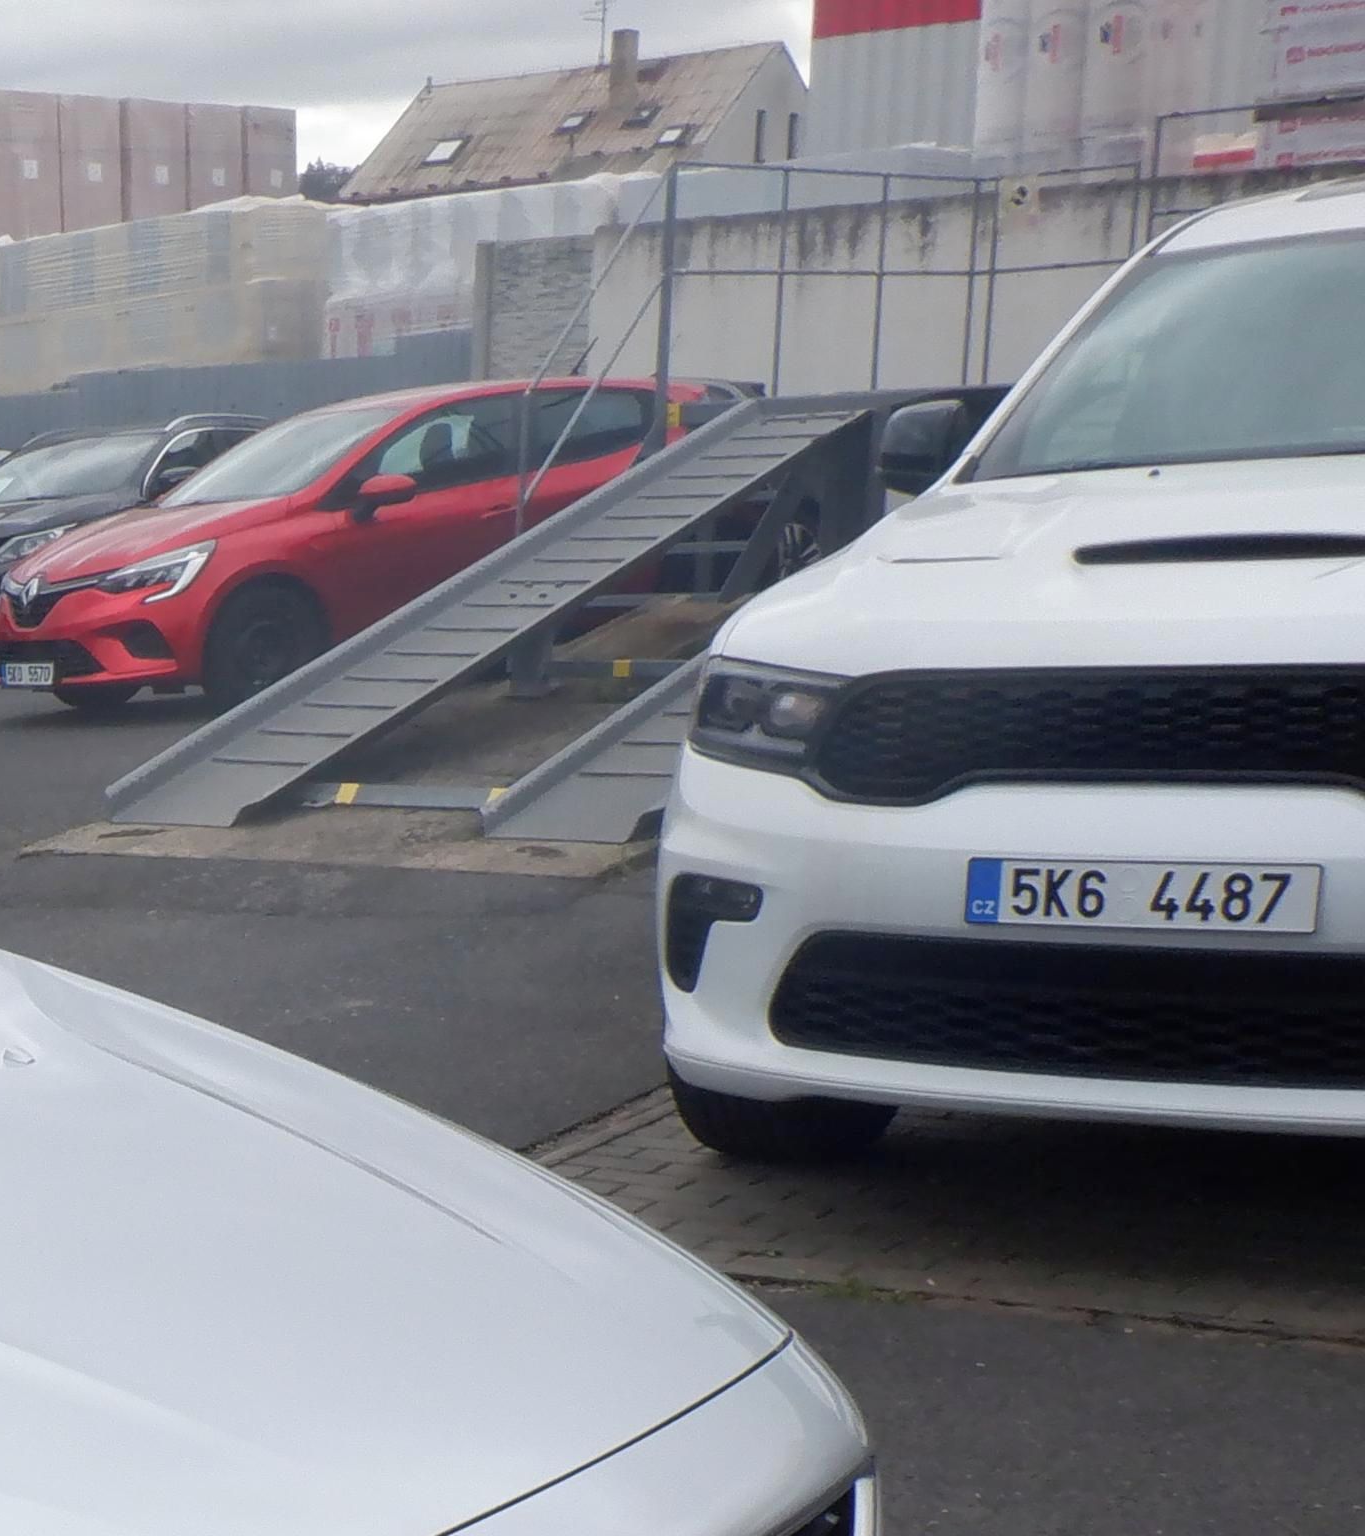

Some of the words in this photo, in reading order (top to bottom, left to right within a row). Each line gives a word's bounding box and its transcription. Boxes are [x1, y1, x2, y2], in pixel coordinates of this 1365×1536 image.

[971, 899, 996, 916] CZ
[1012, 868, 1107, 919] 5K6
[1149, 870, 1292, 924] 4487
